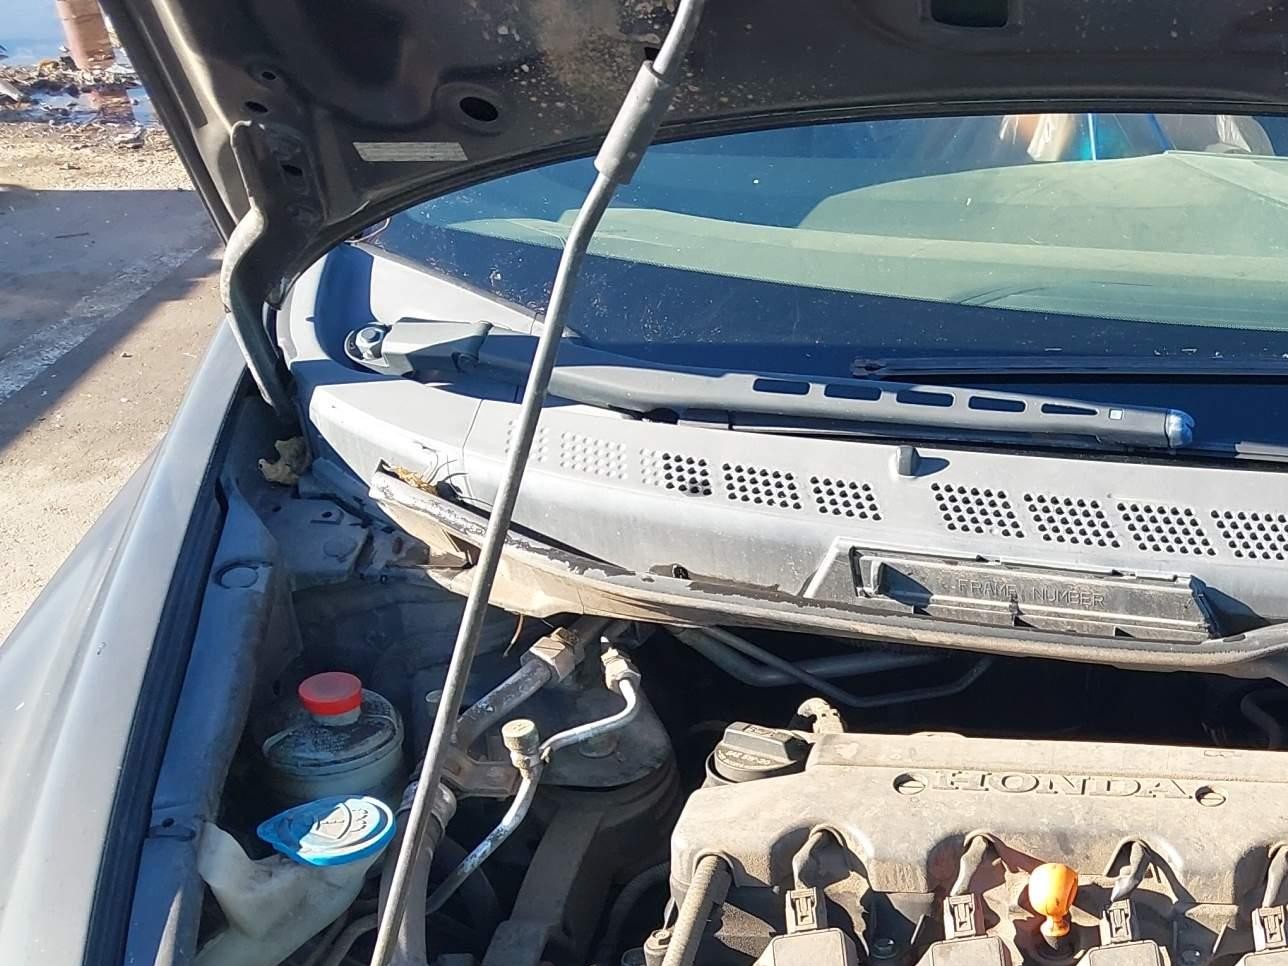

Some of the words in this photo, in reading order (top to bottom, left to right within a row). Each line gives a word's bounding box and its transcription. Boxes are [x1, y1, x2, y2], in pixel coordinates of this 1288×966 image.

[958, 579, 1018, 597] FRAME
[1032, 586, 1105, 607] NUMBER
[931, 770, 1194, 800] HONDA
